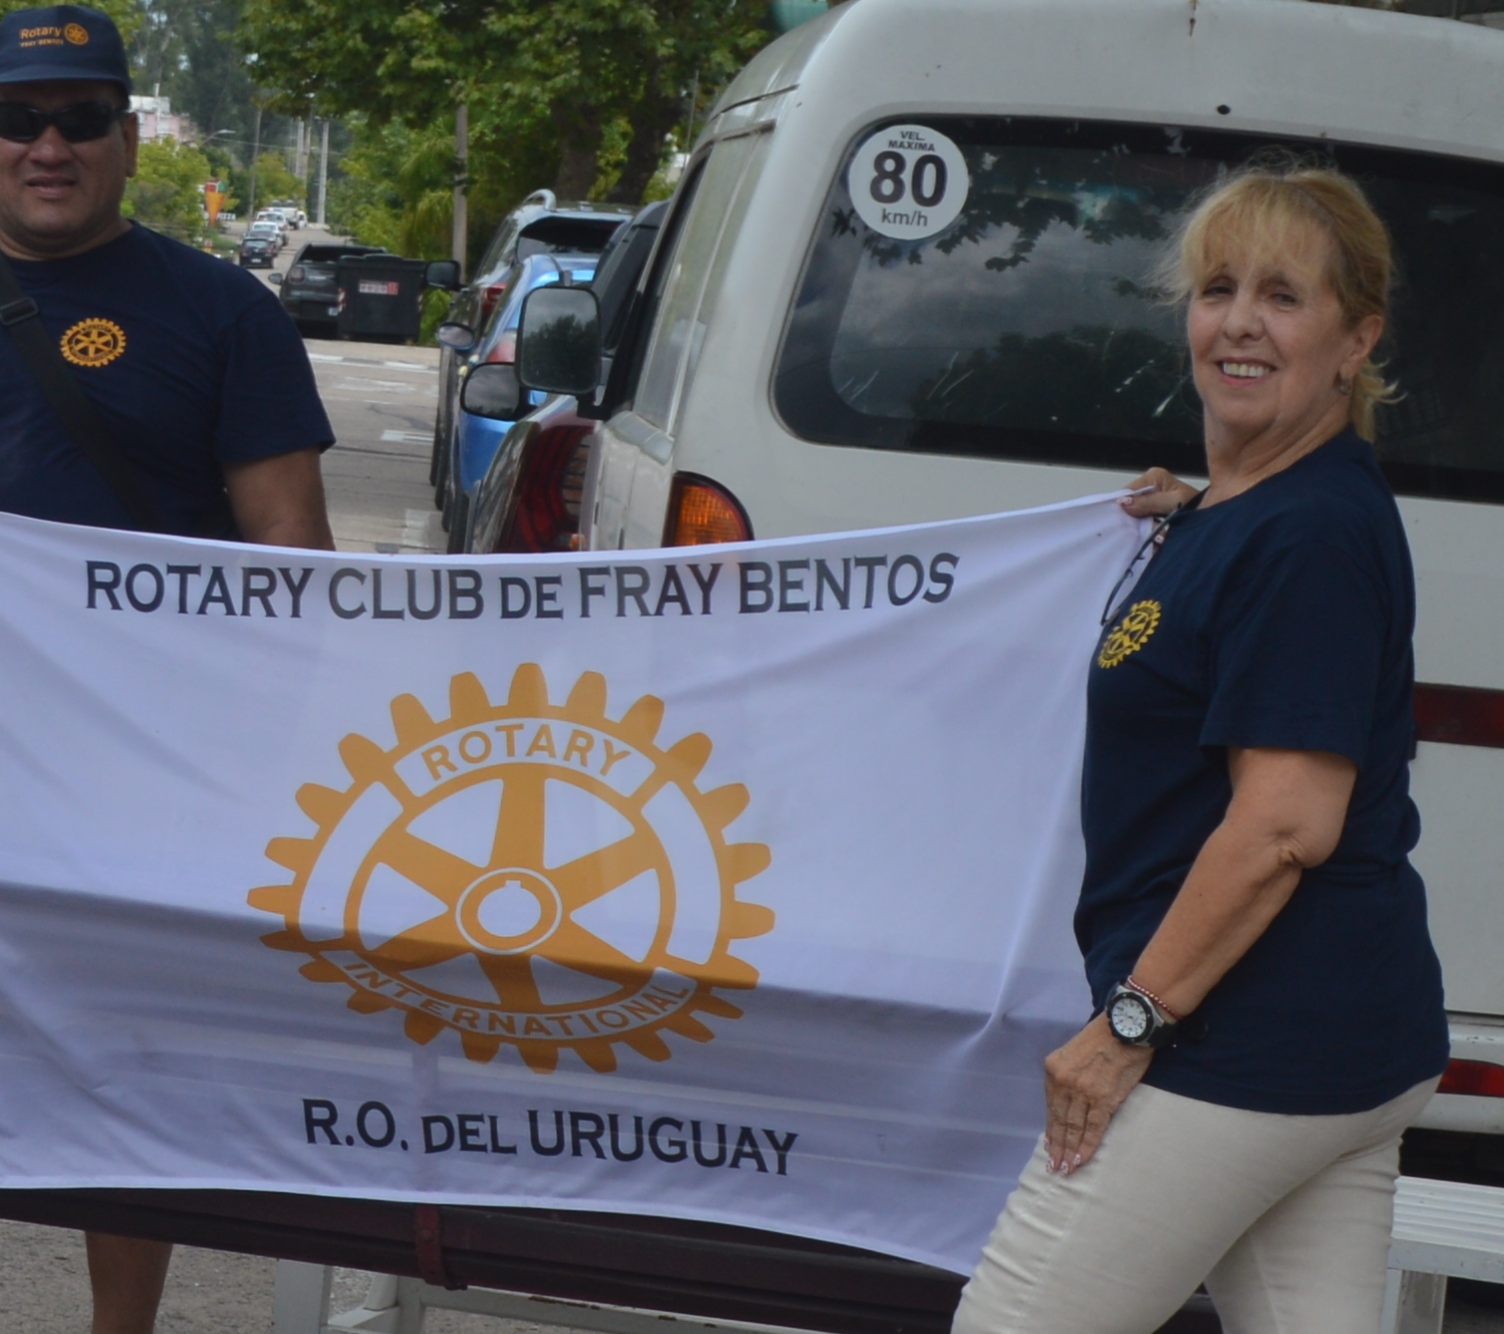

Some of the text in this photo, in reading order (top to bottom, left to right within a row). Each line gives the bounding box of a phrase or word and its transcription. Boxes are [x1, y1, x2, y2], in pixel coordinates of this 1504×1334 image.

[20, 27, 62, 40] Rotary
[870, 150, 948, 208] 80
[881, 208, 929, 227] km/h
[85, 552, 960, 621] ROTARY CLUB DE FRAY BENTOS
[421, 723, 632, 782] ROTARY
[342, 962, 690, 1038] INTERNATIONAL
[302, 1098, 800, 1176] R.O. DEL URUGUAY
